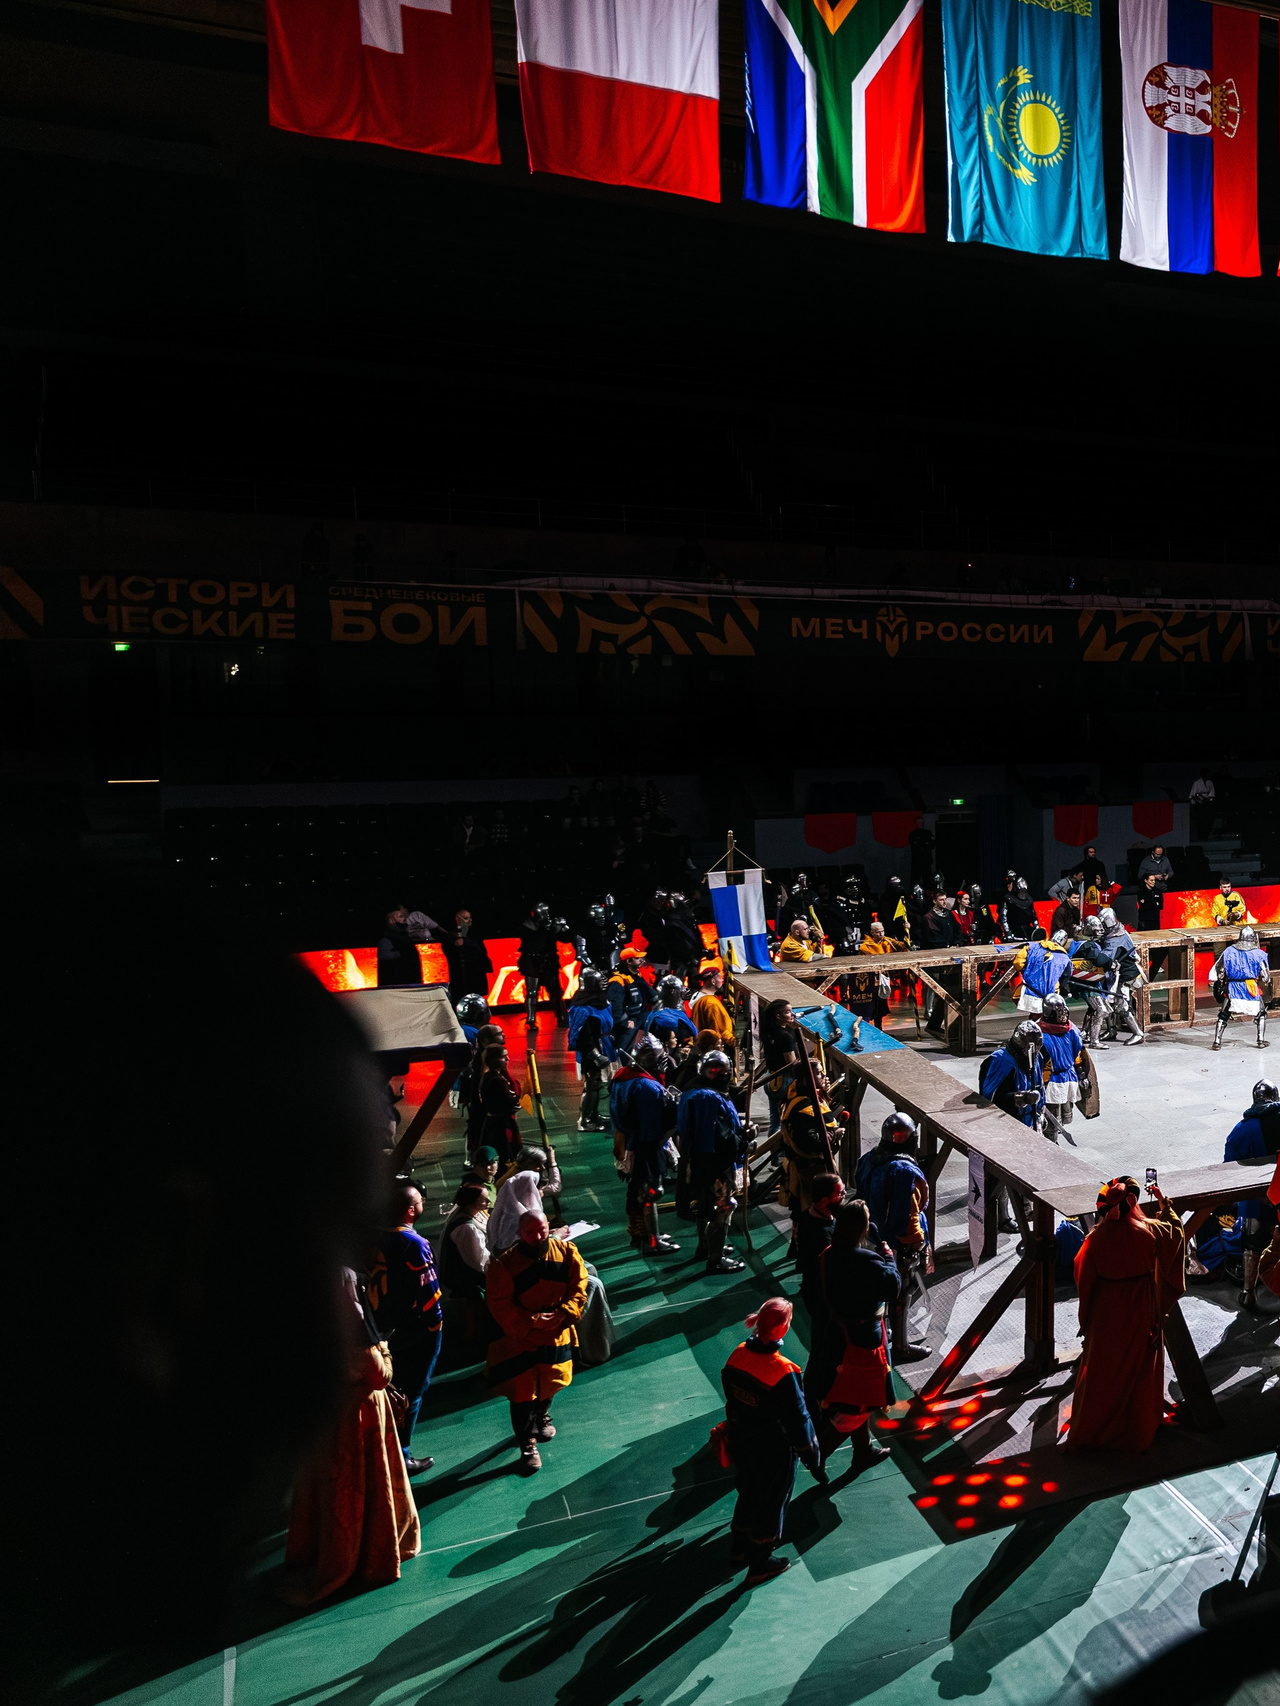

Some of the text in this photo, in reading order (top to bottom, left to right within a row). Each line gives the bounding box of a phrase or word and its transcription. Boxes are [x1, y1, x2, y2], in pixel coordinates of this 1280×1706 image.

[79, 574, 296, 608] ИСТОРИ
[83, 604, 296, 640] ЧЕСКИЕ
[329, 600, 488, 646] БОИ
[791, 616, 1054, 644] МЕЧ РОССИИ
[851, 992, 874, 1002] МЕЧ
